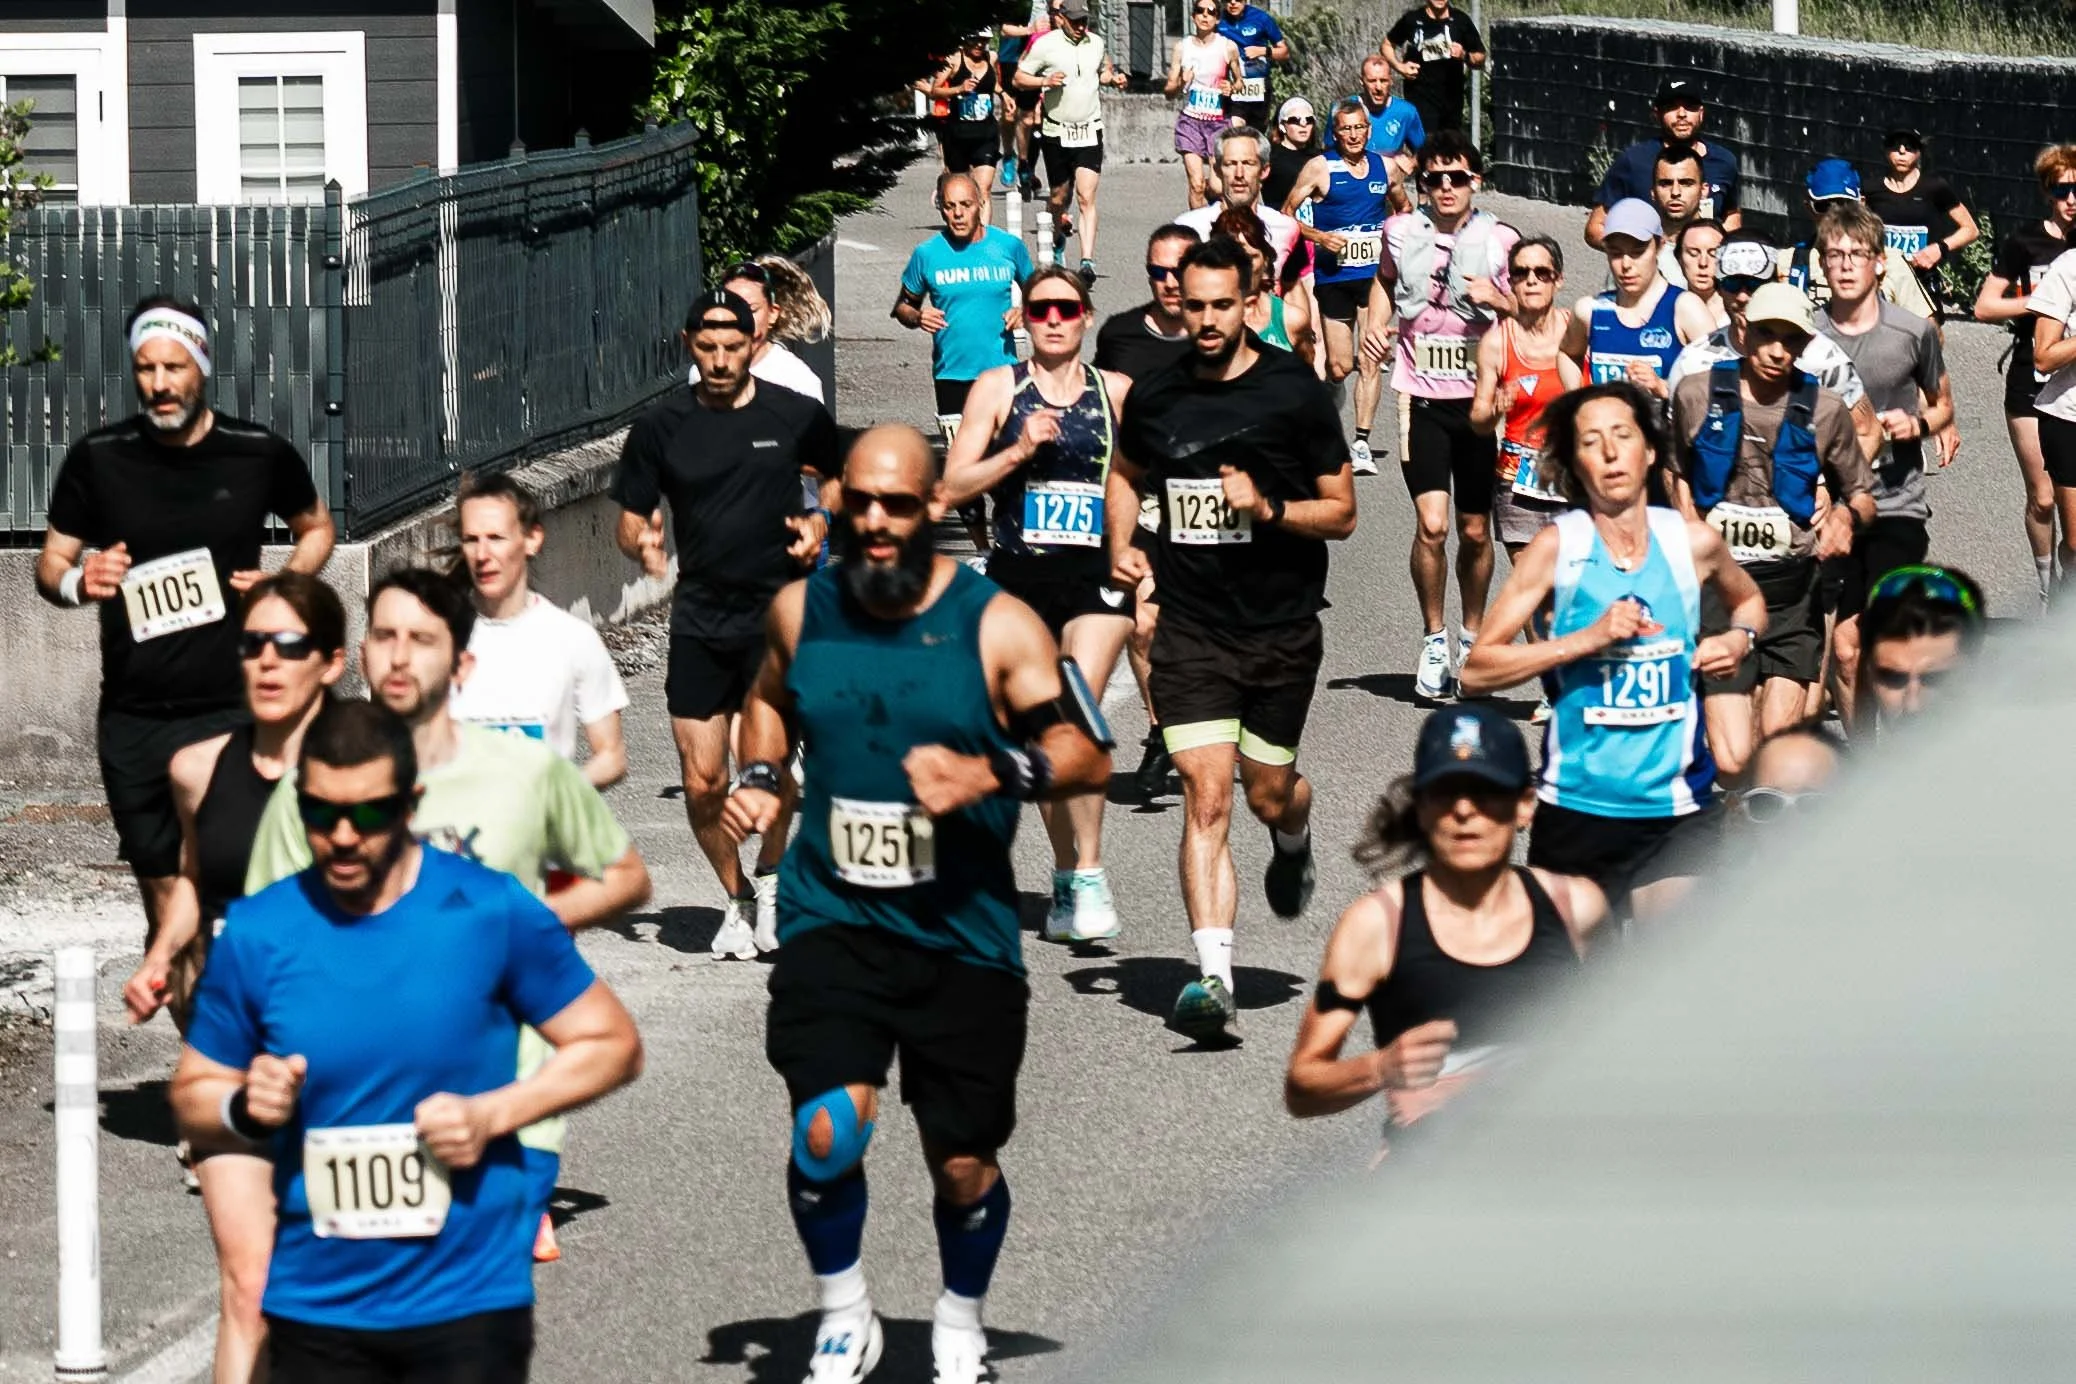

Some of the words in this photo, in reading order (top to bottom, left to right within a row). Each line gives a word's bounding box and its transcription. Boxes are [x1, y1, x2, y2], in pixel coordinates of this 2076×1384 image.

[1344, 241, 1373, 260] 1061
[1886, 231, 1919, 254] 1273
[935, 267, 970, 286] RUN
[1427, 345, 1467, 370] 1119
[1034, 494, 1093, 532] 1275
[1720, 519, 1777, 550] 1108
[137, 570, 203, 621] 1105
[1598, 659, 1671, 708] 1291
[842, 820, 916, 869] 1251
[325, 1151, 426, 1211] 1109
